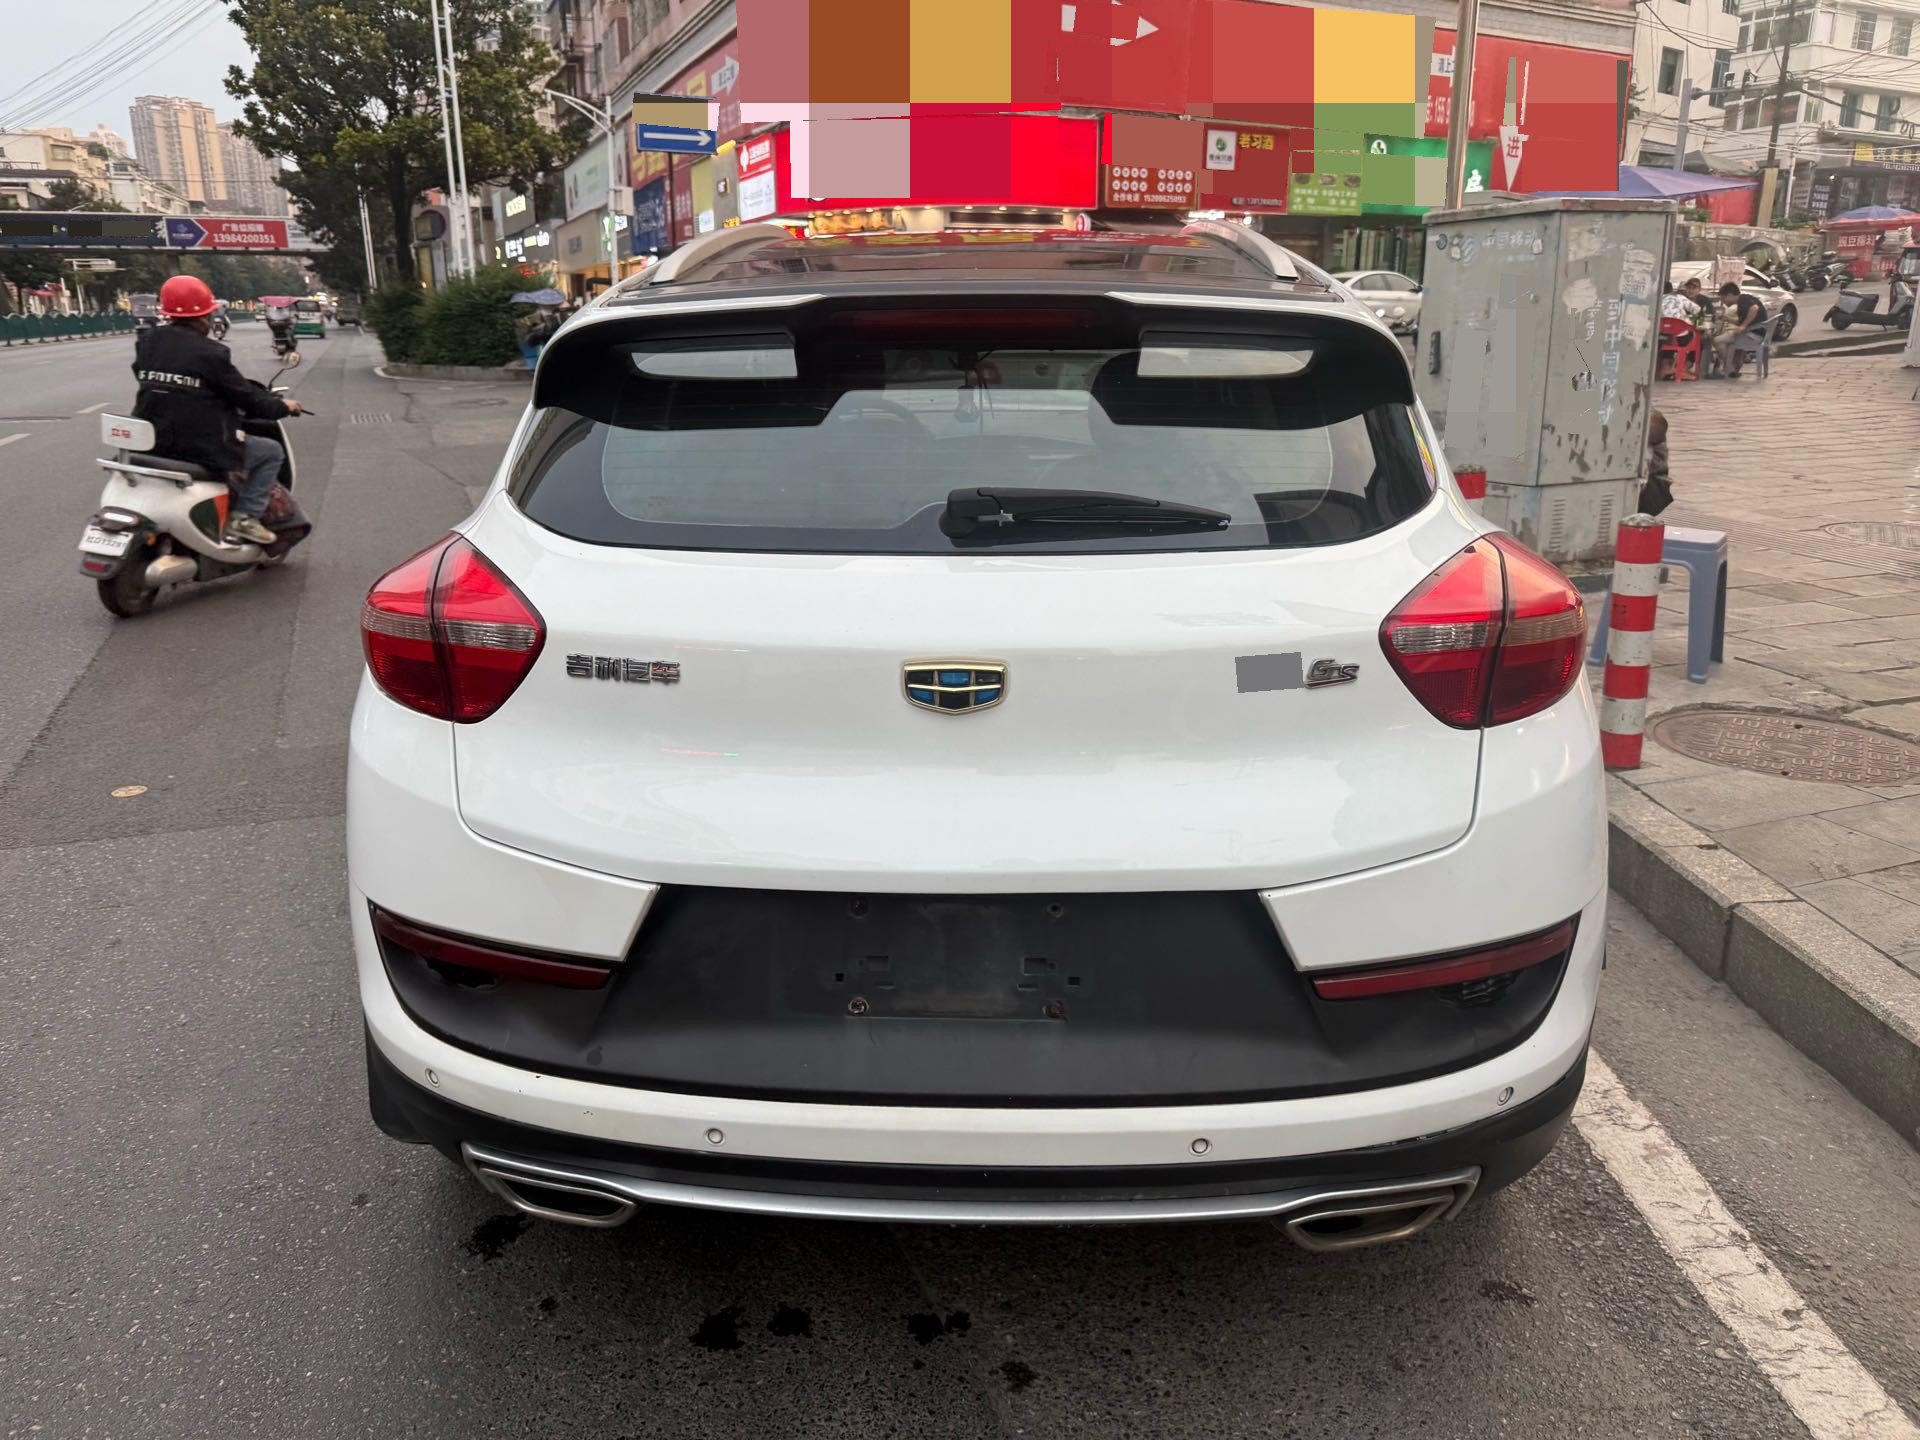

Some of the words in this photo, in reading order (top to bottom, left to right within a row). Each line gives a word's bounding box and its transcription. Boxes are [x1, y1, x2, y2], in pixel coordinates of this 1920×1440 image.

[1239, 133, 1274, 151] 老习酒
[566, 653, 681, 684] 吉利汽车
